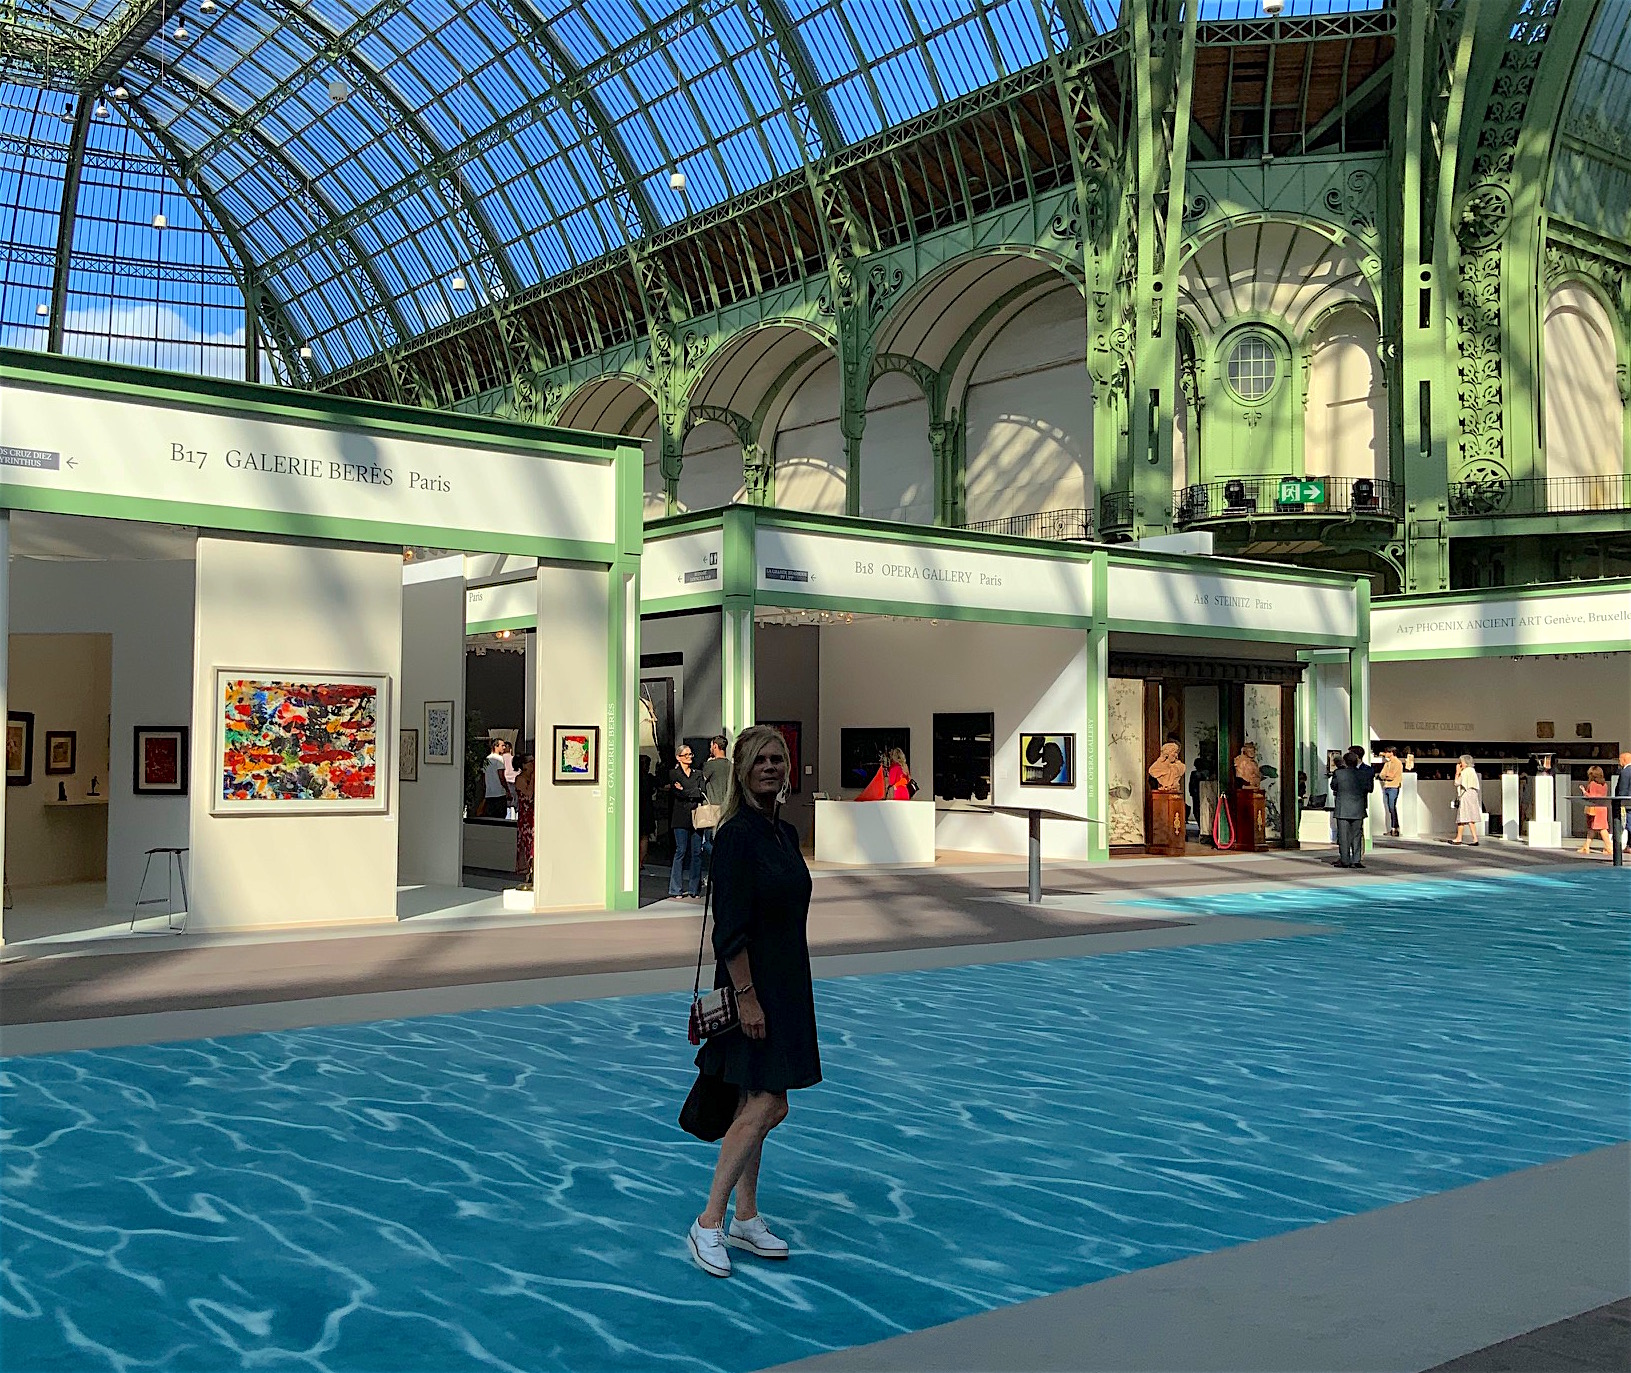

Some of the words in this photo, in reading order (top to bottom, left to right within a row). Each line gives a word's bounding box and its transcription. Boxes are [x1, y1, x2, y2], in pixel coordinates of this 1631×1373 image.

[9, 448, 32, 459] CRUZ
[33, 451, 53, 461] DIEZ
[170, 442, 208, 469] B17
[225, 449, 323, 479] GALERIE
[328, 461, 394, 487] BERÈS
[408, 471, 452, 493] Paris
[854, 561, 874, 575] B18
[881, 563, 920, 579] OPERA
[922, 567, 972, 584] GALLERY
[979, 573, 1002, 586] Paris
[468, 591, 483, 603] Paris
[1193, 594, 1209, 605] A18
[1214, 595, 1250, 608] STEINITZ
[1255, 598, 1273, 610] Paris
[1396, 624, 1414, 635] A17
[1416, 620, 1464, 633] PHOENIX
[1466, 617, 1516, 630] ANCIENT
[1518, 615, 1542, 627] ART
[1544, 613, 1586, 625] Genève,
[607, 739, 615, 789] GALERIE
[607, 795, 616, 814] B17
